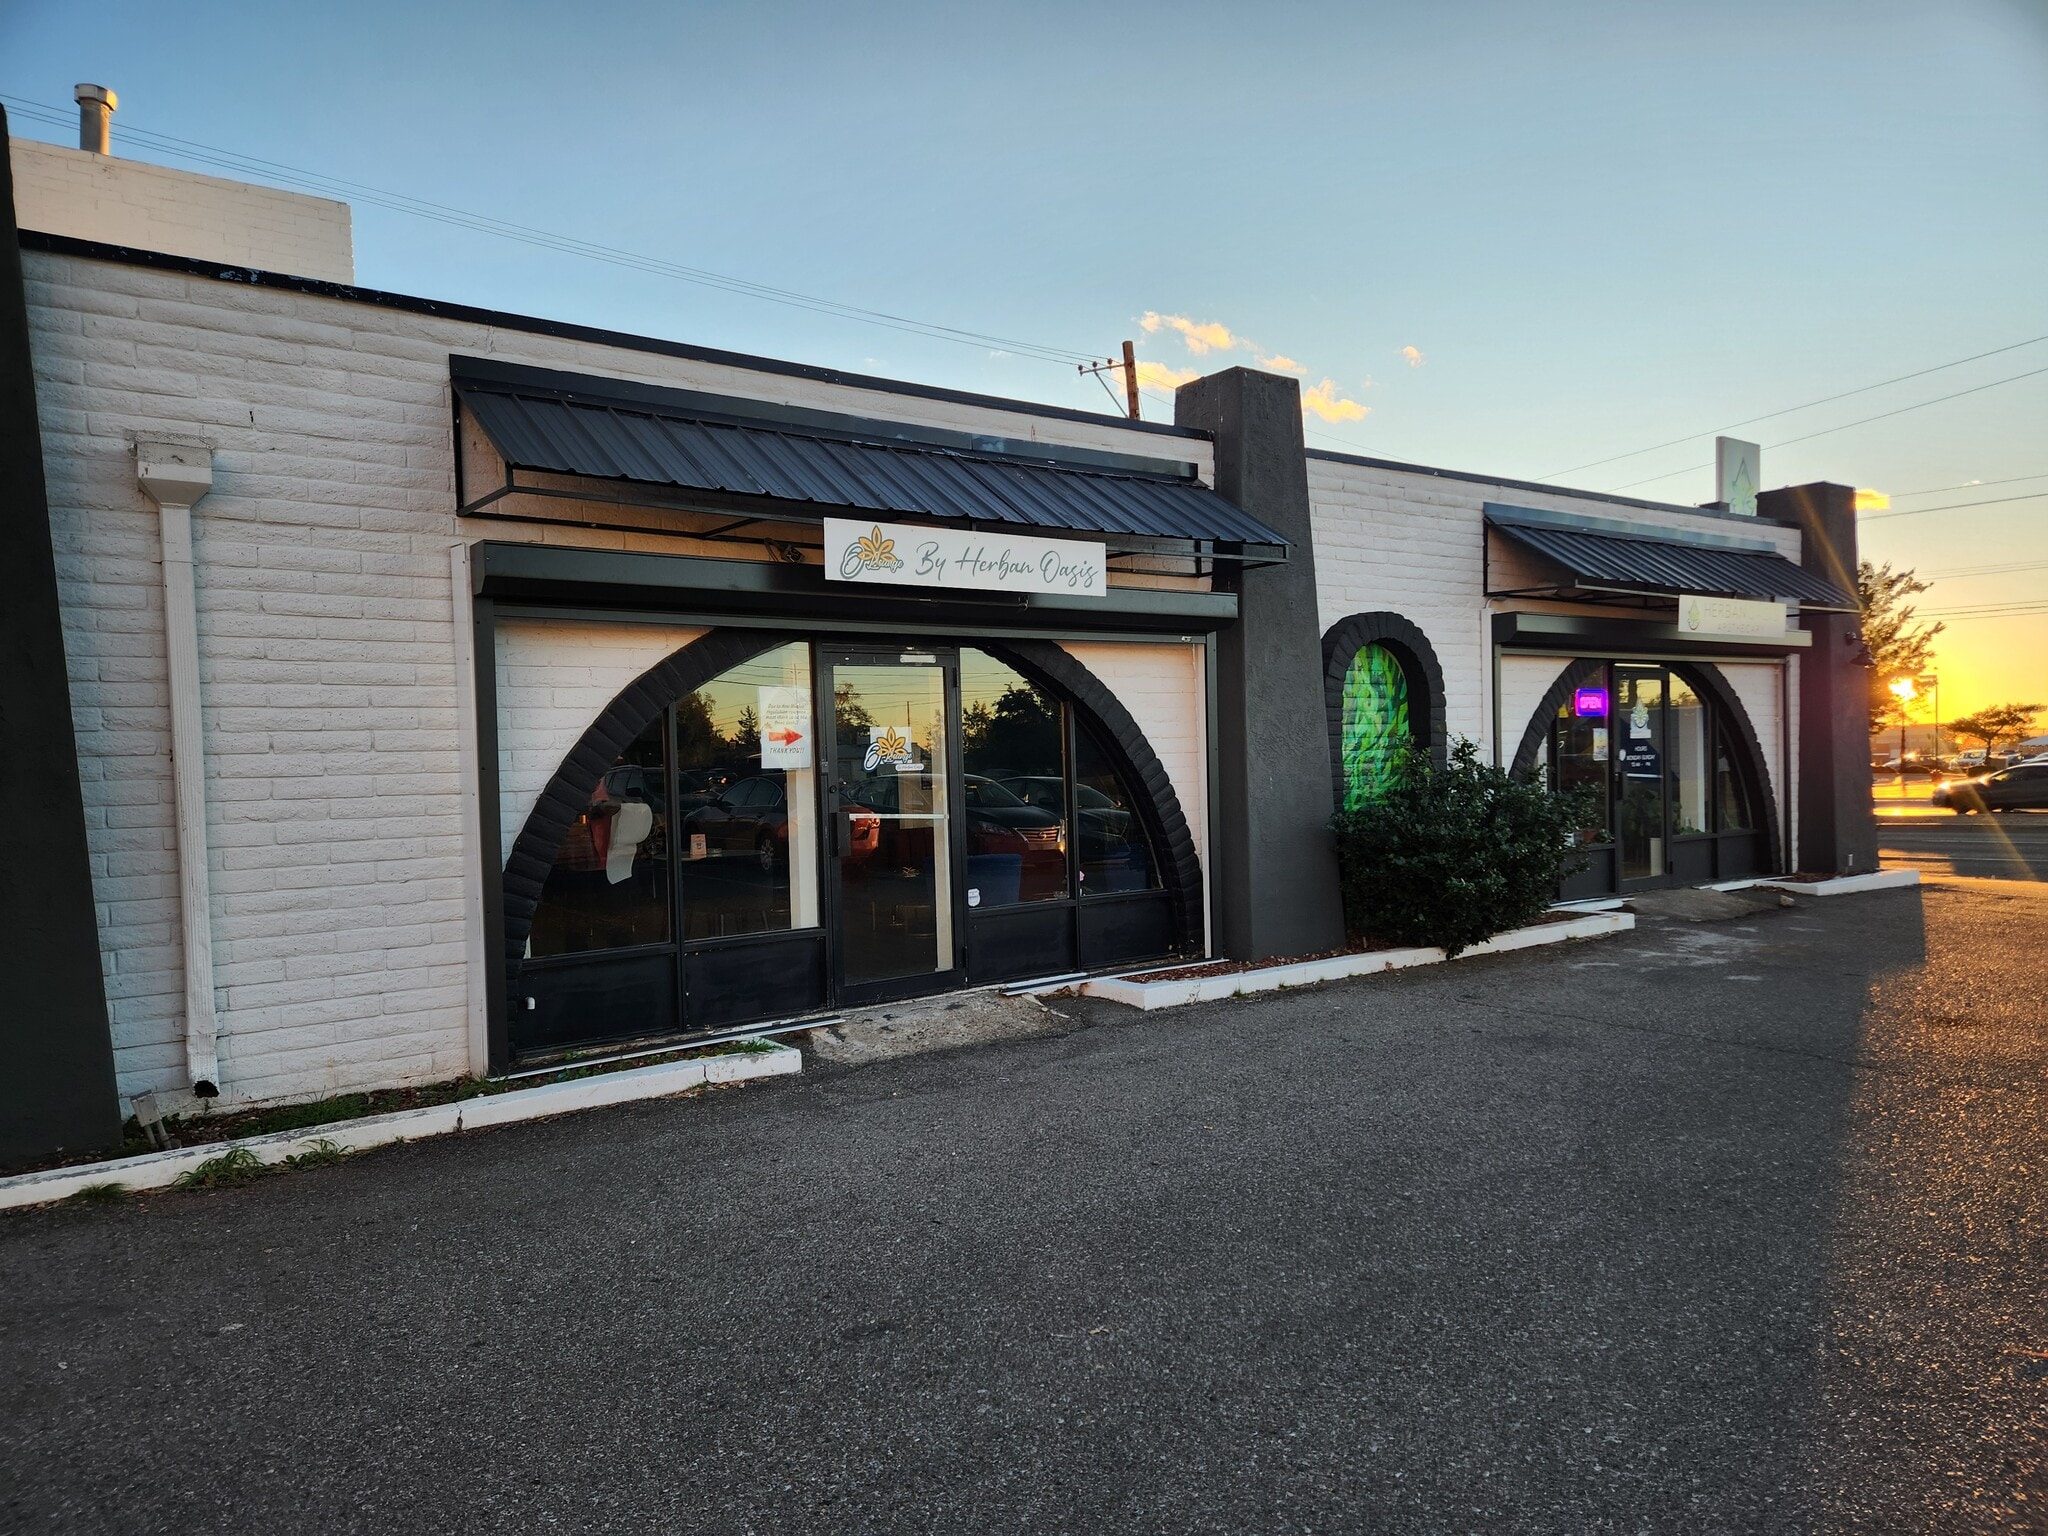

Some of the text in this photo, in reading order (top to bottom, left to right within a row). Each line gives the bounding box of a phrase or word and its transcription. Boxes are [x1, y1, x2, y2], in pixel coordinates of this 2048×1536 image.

[916, 541, 1099, 588] By Herban Oasis
[1580, 696, 1602, 709] OPEN
